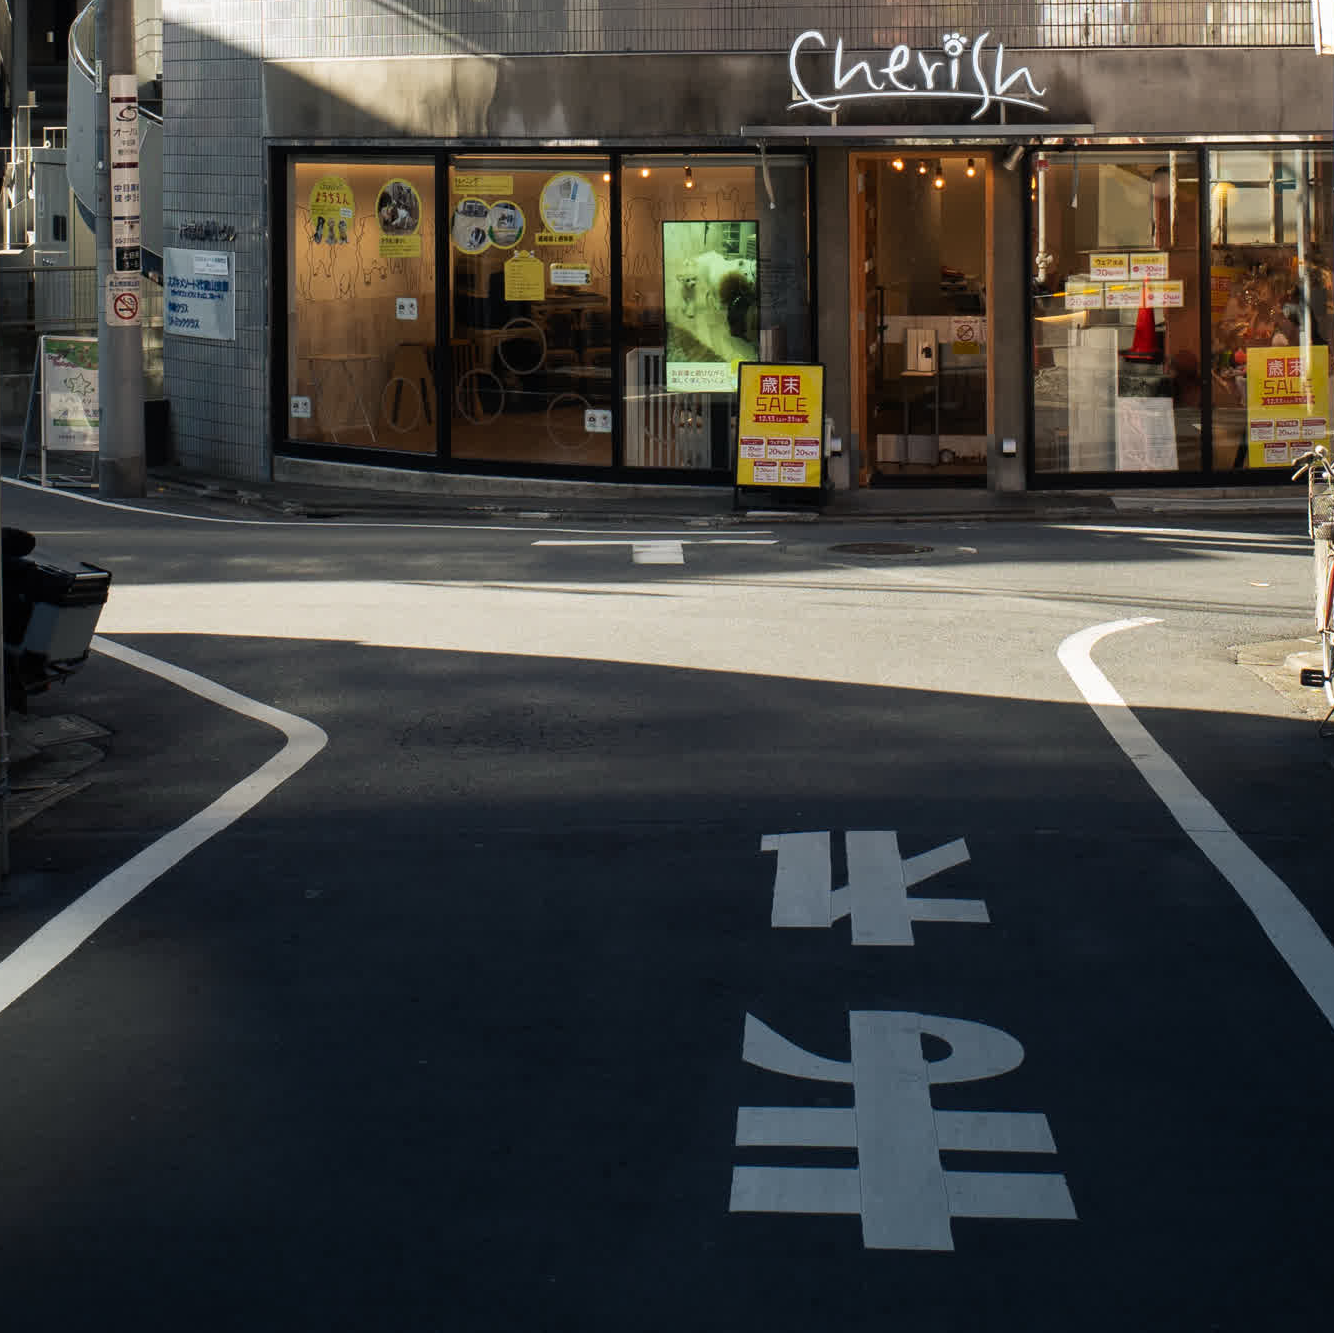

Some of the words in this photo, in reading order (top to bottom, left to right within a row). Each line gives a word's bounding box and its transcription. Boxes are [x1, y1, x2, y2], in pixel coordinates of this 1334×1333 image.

[1268, 358, 1308, 377] 歳末
[761, 376, 799, 394] 歳末
[1263, 379, 1314, 395] SALE
[756, 397, 808, 412] SALE
